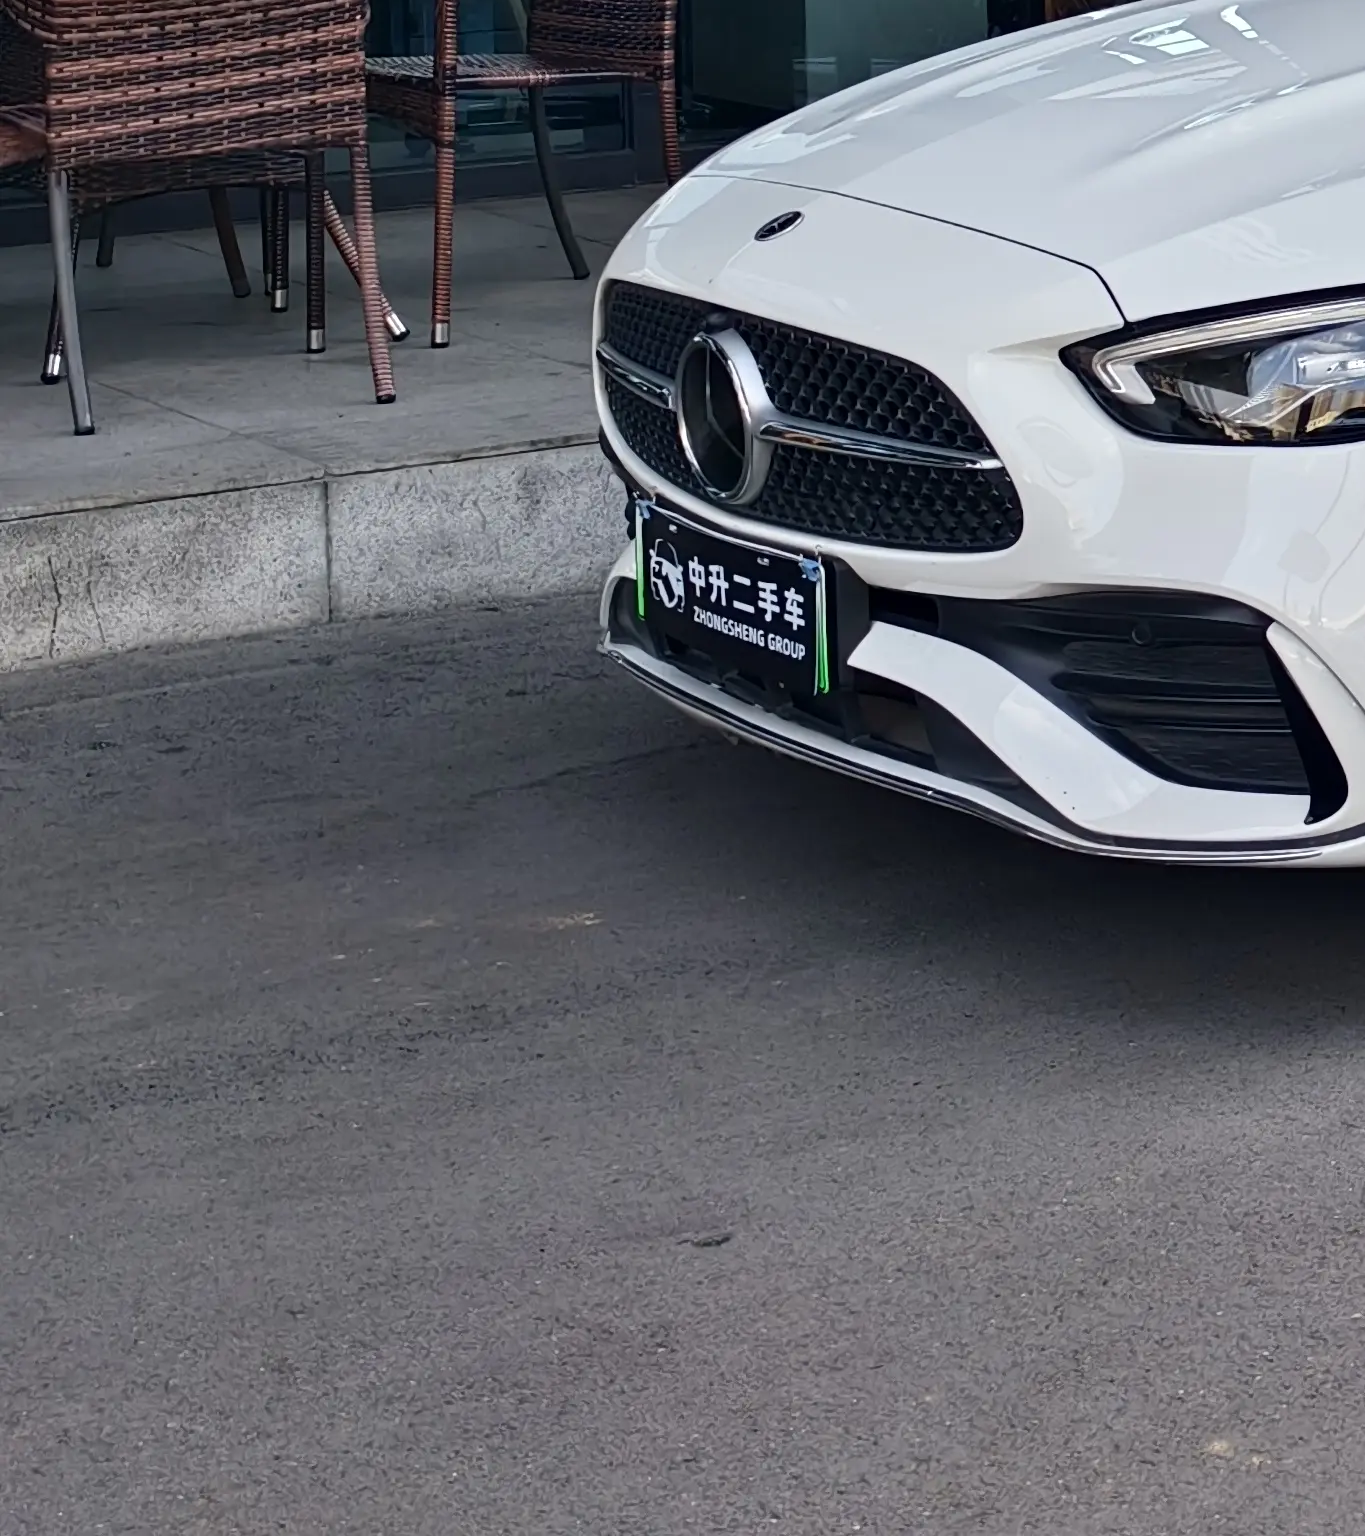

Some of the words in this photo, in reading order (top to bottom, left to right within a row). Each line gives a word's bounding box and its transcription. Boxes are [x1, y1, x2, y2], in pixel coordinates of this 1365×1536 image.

[688, 555, 806, 632] 中升二手车
[692, 605, 766, 648] ZHONGSHENG
[767, 632, 806, 661] GROUP
